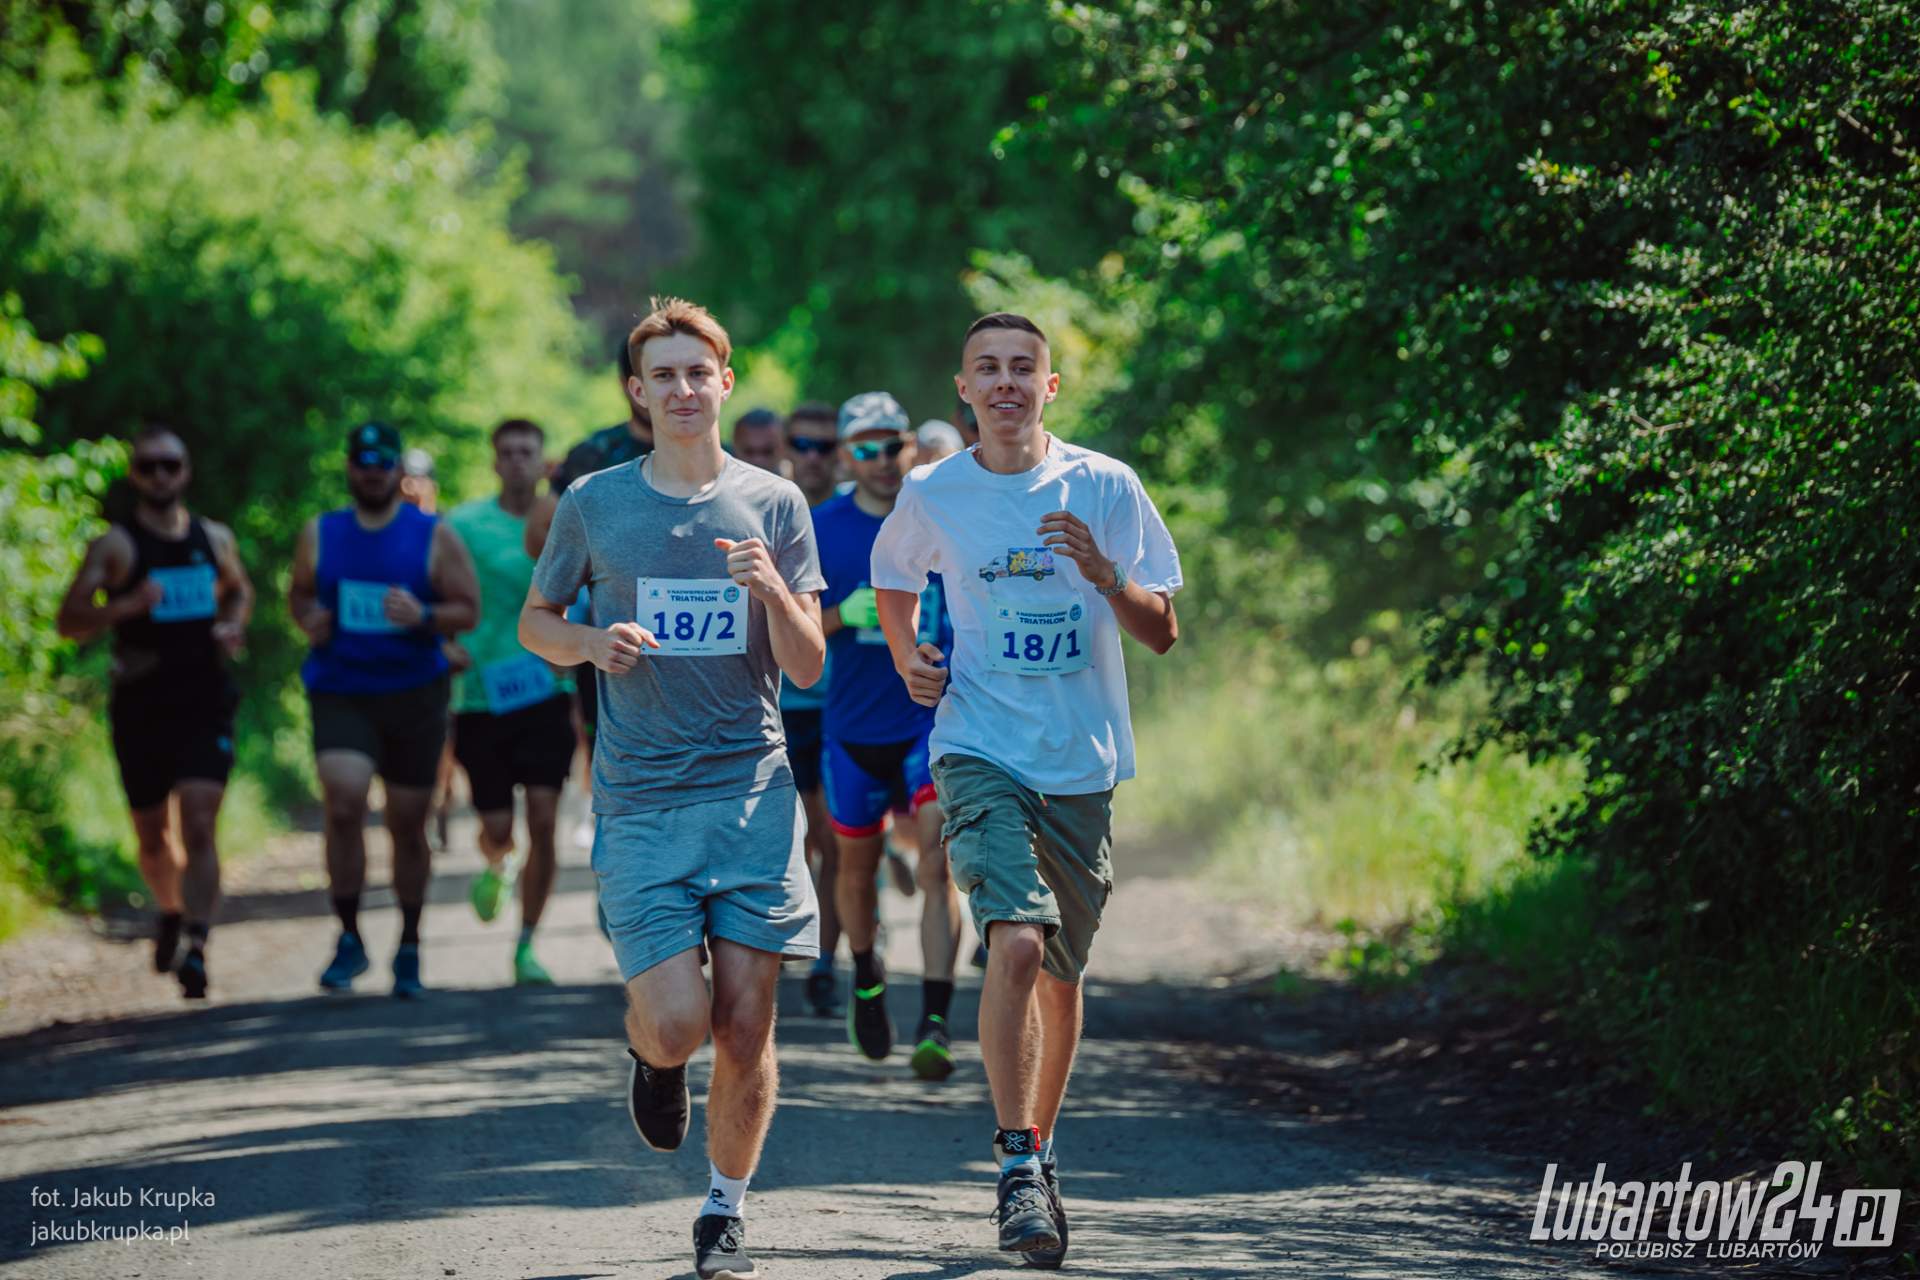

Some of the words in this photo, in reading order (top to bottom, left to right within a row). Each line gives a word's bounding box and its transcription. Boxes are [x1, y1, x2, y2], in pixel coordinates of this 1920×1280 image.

[670, 594, 718, 603] TRIATHLON
[653, 610, 735, 642] 18/2
[1018, 616, 1065, 625] TRIATHLON
[1002, 628, 1081, 663] 18/1
